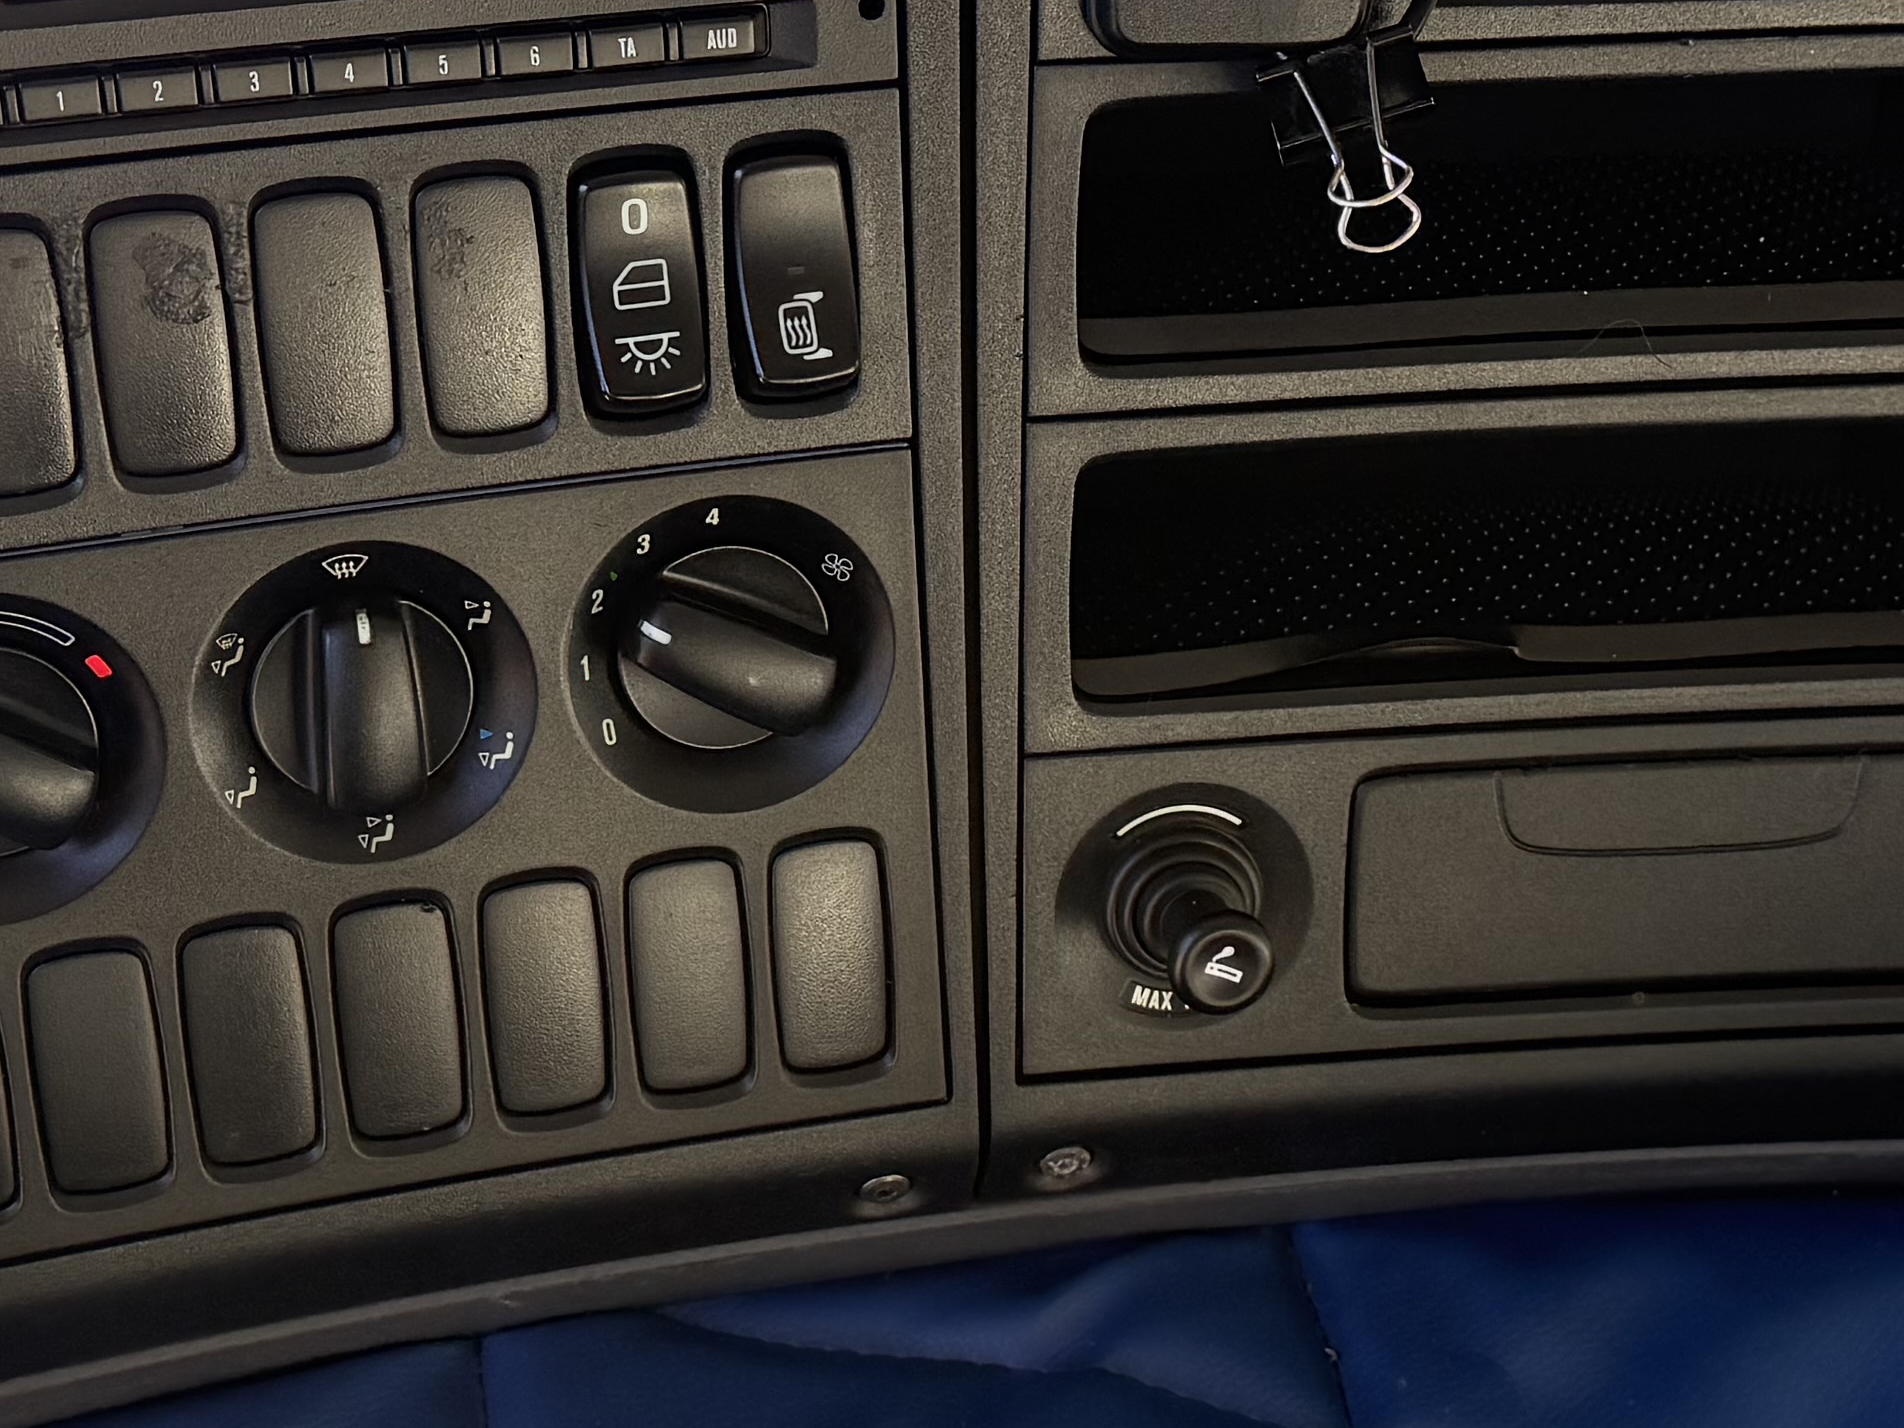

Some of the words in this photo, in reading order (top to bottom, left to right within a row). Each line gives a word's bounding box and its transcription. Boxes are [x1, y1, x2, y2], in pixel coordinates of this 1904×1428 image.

[617, 36, 637, 59] TA
[706, 28, 738, 51] AUD
[438, 54, 449, 76] 5
[529, 46, 541, 67] 6
[249, 70, 261, 93] 3
[344, 62, 356, 83] 4
[55, 90, 65, 112] 1
[152, 80, 164, 102] 2
[705, 508, 720, 525] 4
[636, 534, 651, 555] 3
[591, 589, 604, 614] 2
[580, 655, 590, 681] 1
[602, 718, 617, 746] 0
[1131, 984, 1173, 1011] MAX
